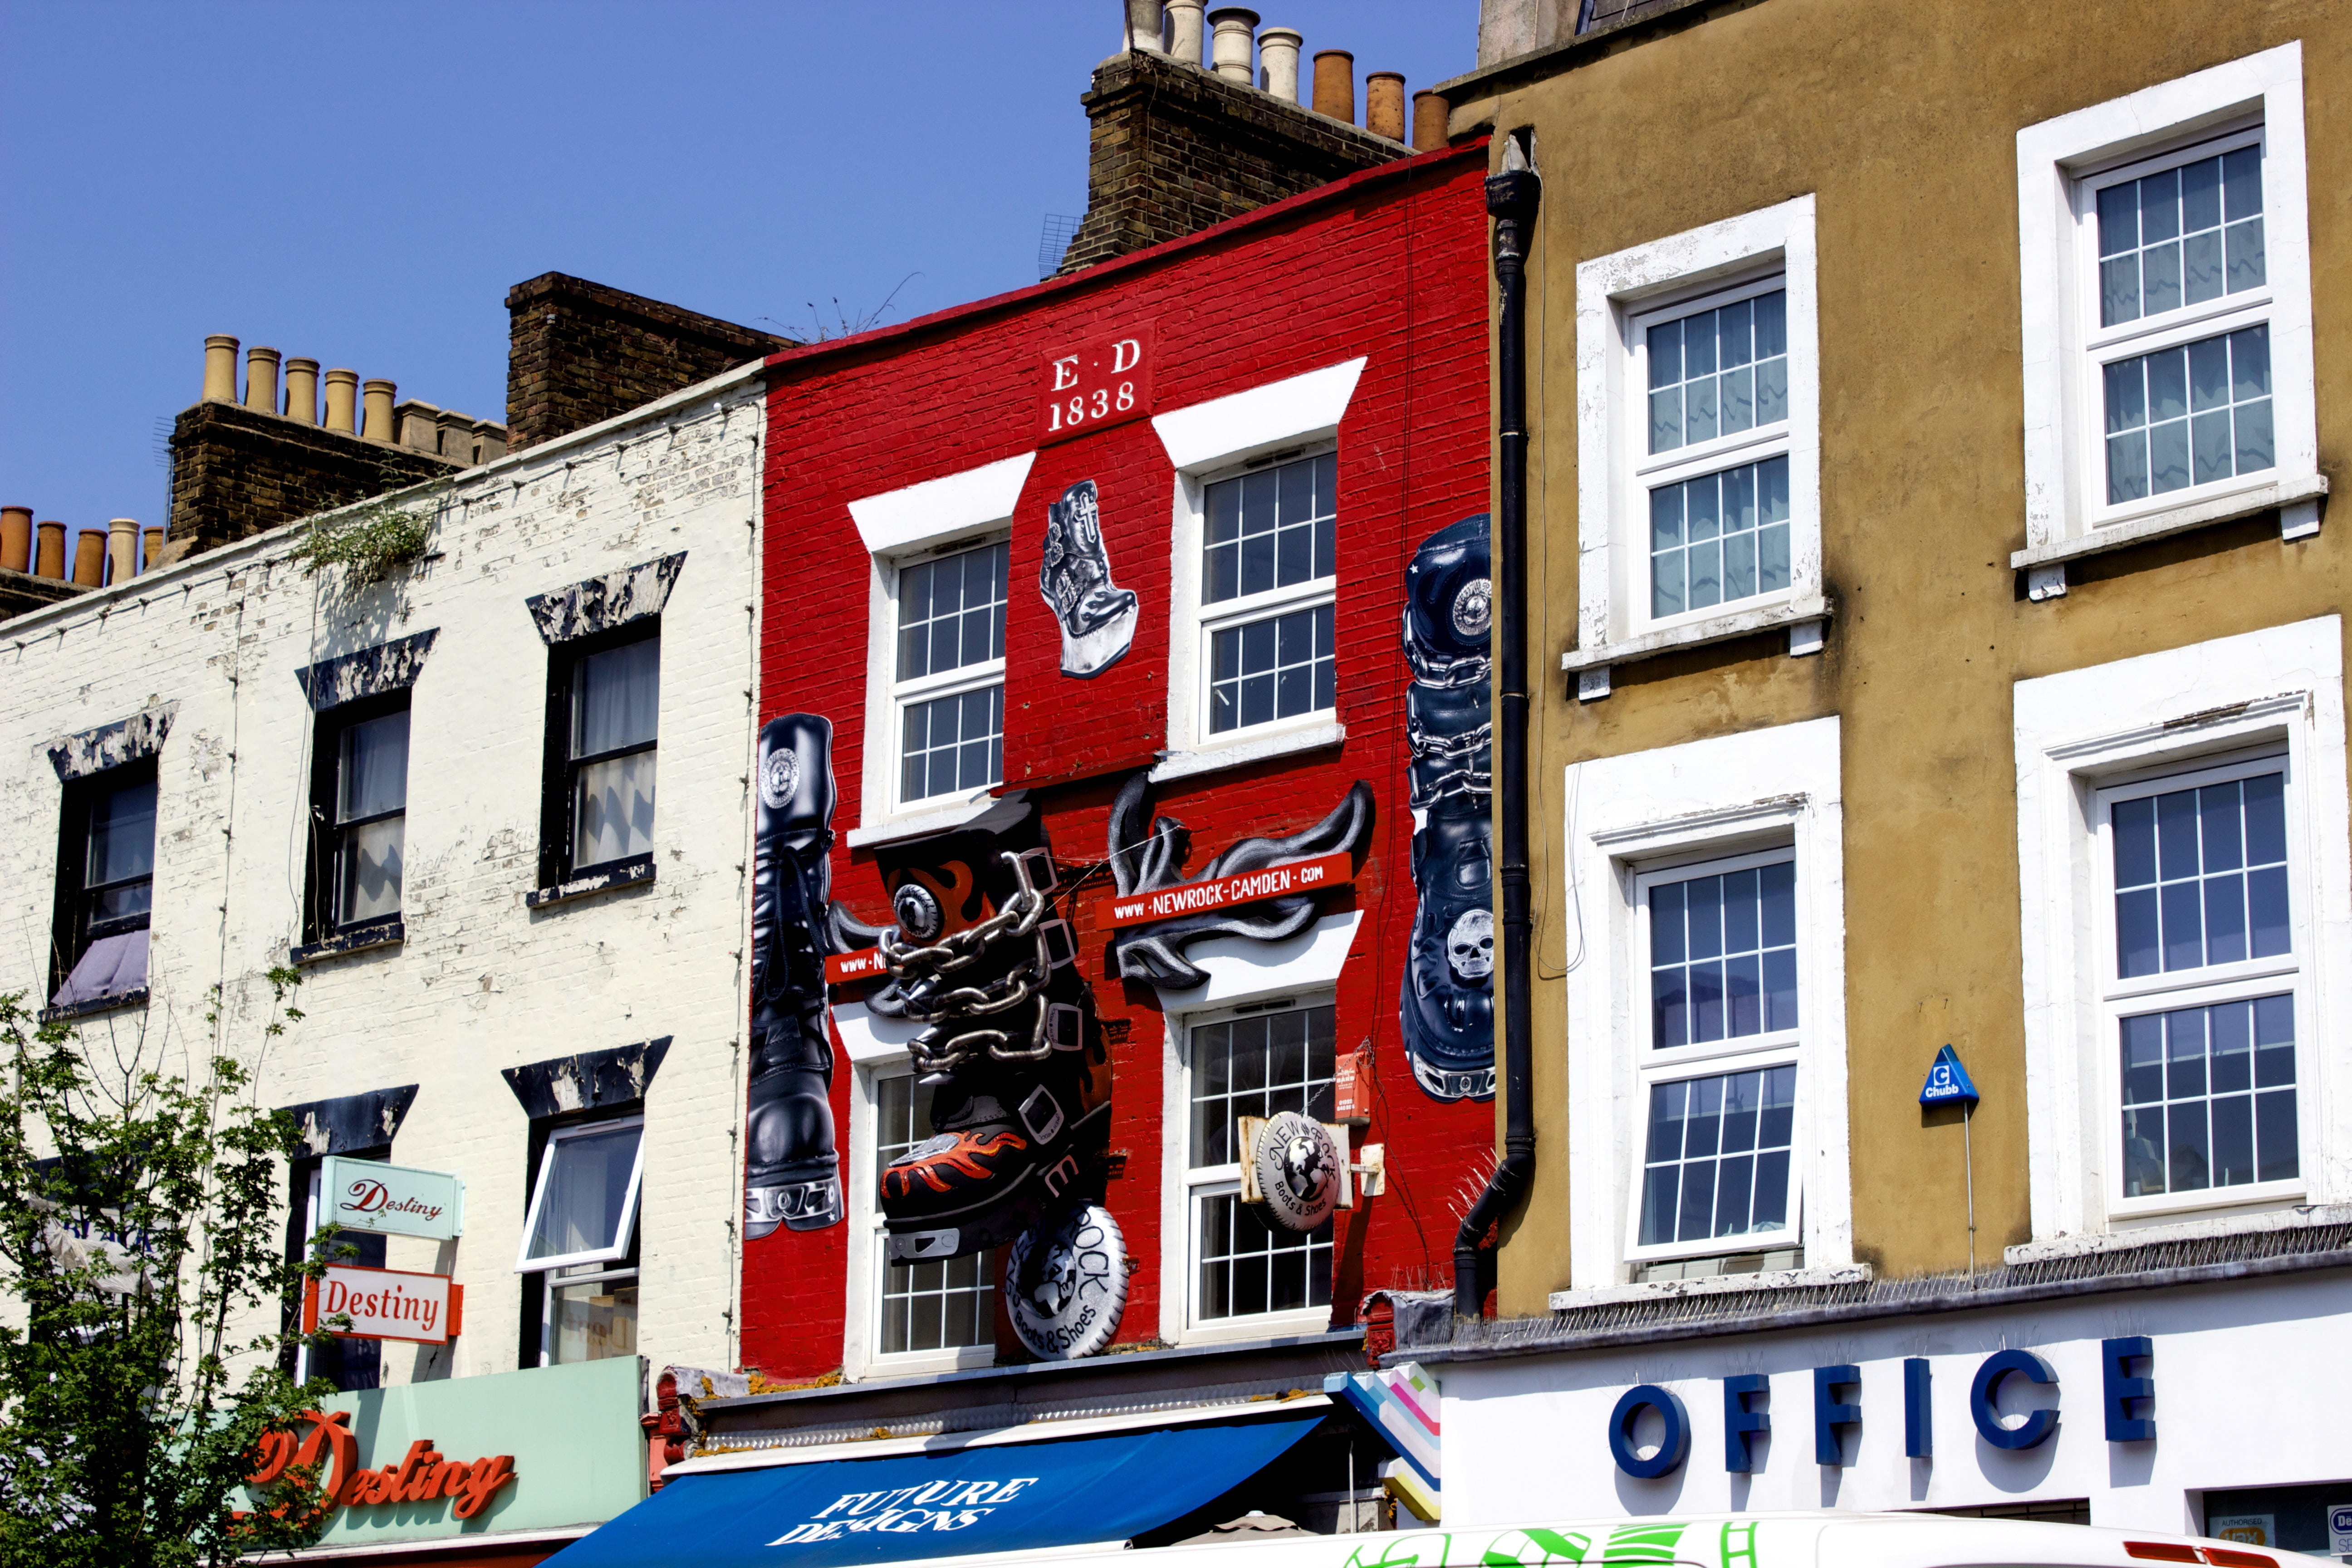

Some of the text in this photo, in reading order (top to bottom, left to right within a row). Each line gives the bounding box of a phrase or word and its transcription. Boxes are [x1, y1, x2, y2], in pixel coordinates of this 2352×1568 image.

[1049, 382, 1134, 431] 1838
[1925, 1084, 1959, 1098] Chubb
[1269, 1120, 1336, 1181] NEW ROCK
[340, 1179, 443, 1221] Destiny
[1275, 1181, 1326, 1216] Boots & Shoes
[1066, 1206, 1110, 1300] ROCK
[324, 1280, 439, 1331] Destiny
[1015, 1304, 1097, 1354] Boots & Shoes
[1609, 1336, 2156, 1479] OFFICE
[226, 1410, 517, 1537] Destiny
[810, 1478, 1039, 1519] FUTURE
[2222, 1518, 2262, 1526] AUTHORISED
[764, 1508, 996, 1546] DESIGNS
